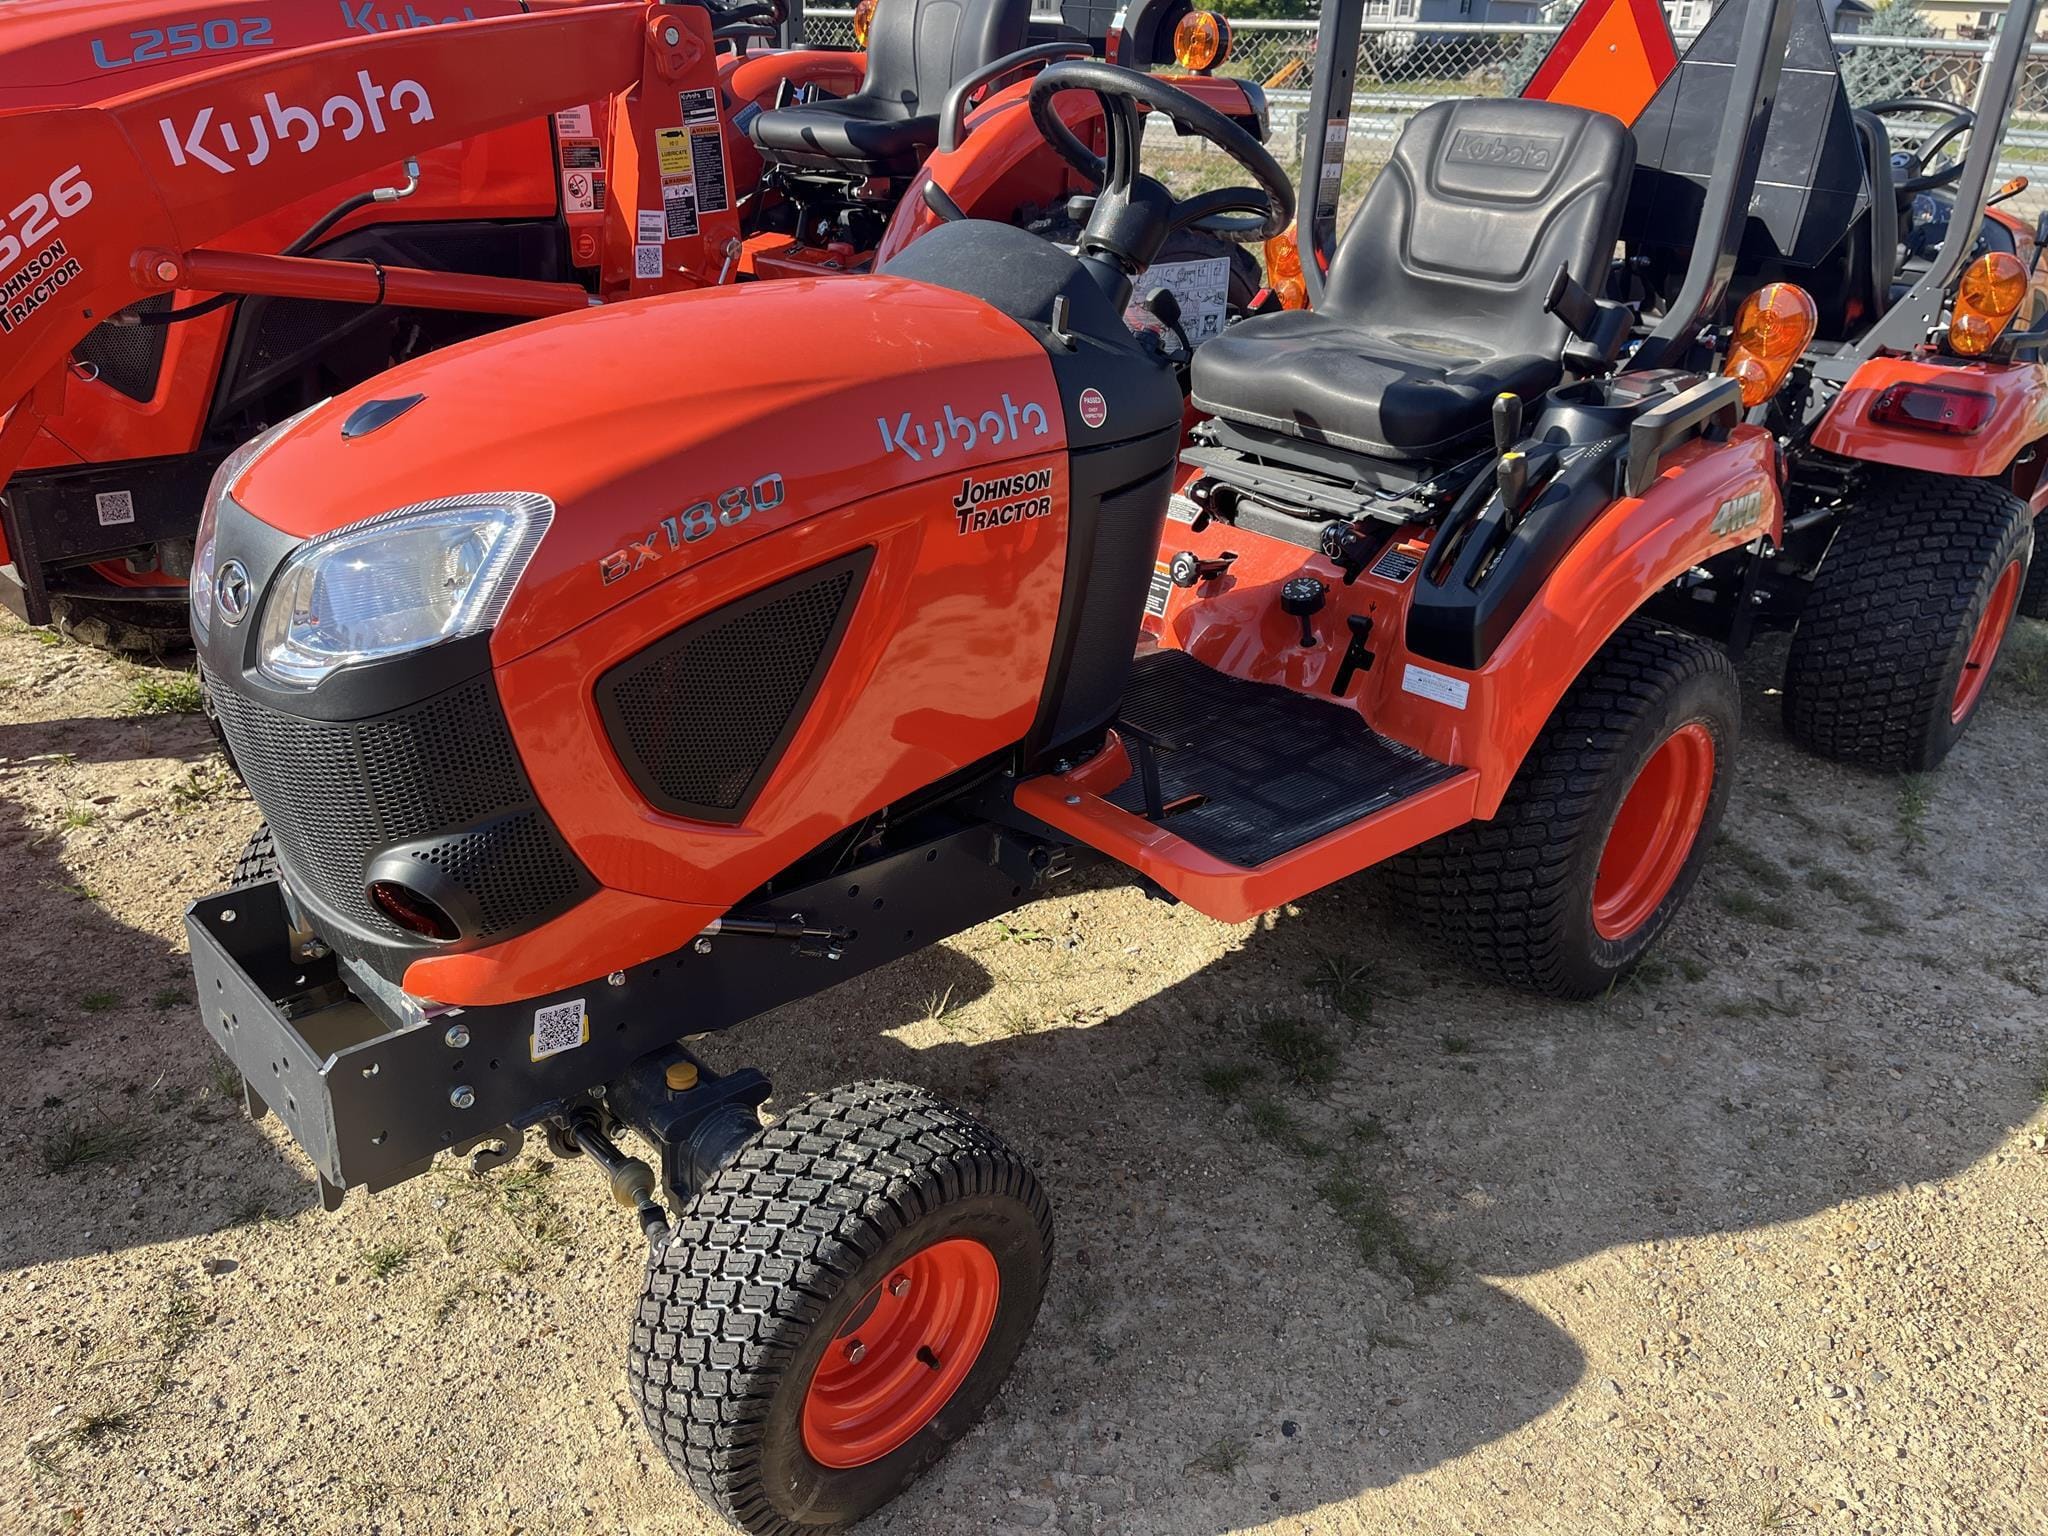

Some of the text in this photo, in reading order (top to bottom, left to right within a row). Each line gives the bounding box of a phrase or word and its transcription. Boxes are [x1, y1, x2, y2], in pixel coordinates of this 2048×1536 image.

[91, 17, 274, 69] L2502
[159, 70, 435, 174] Kubota
[1457, 135, 1550, 168] Kubota
[877, 393, 1049, 461] Kubota
[953, 468, 1052, 508] JOHNSON
[600, 473, 785, 587] BX1880
[957, 496, 1051, 535] TRACTOR
[1710, 491, 1761, 537] 4WD
